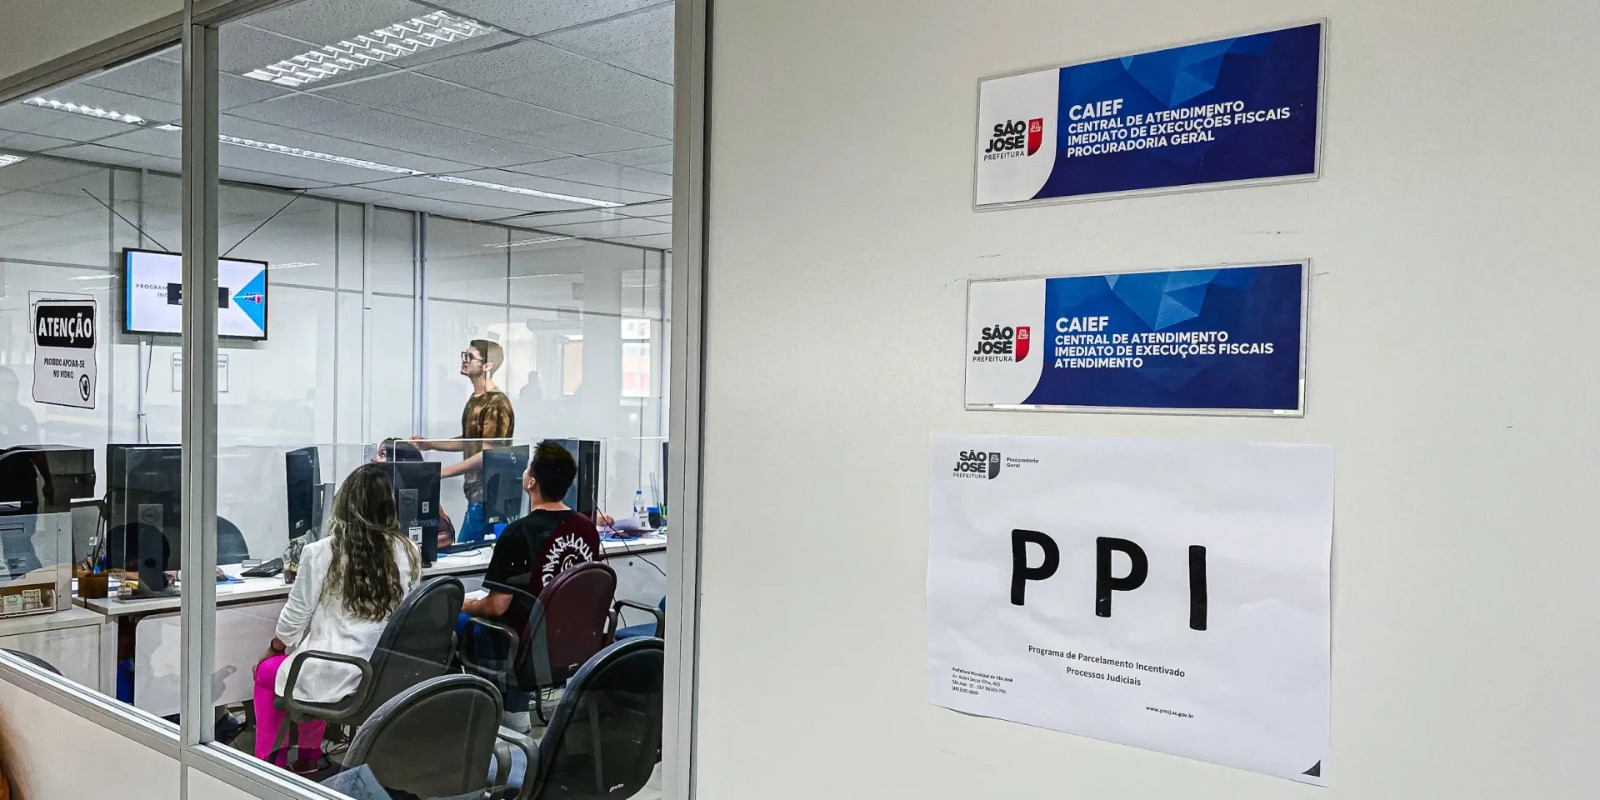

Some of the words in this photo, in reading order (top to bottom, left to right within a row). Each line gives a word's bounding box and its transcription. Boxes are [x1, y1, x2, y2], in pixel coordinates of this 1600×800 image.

[1068, 118, 1123, 134] CENTRAL
[1126, 114, 1143, 127] DE
[1145, 101, 1244, 124] ATENDIMENTO
[1069, 99, 1123, 120] CAIEF
[993, 119, 1026, 137] SÃO
[1068, 129, 1127, 145] IMEDIATO
[1130, 126, 1147, 138] DE
[1150, 113, 1231, 135] EXECUÇÕES
[1234, 107, 1290, 125] FISCAIS
[985, 134, 1025, 153] JOSÉ
[1067, 136, 1167, 157] PROCURADORIA
[1171, 130, 1215, 145] GERAL
[984, 150, 1024, 161] PREFEITURA
[38, 312, 92, 343] ATENÇÃO
[982, 324, 1014, 340] SÃO
[1055, 316, 1109, 332] CAIEF
[974, 339, 1012, 354] JOSÉ
[1055, 334, 1109, 345] CENTRAL
[1112, 333, 1128, 344] DE
[1131, 331, 1228, 344] ATENDIMENTO
[1055, 346, 1114, 356] IMEDIATO
[1116, 345, 1133, 356] DE
[1135, 340, 1216, 358] EXECUÇÕES
[1218, 343, 1273, 354] FISCAIS
[43, 357, 62, 366] PROIBIDO
[62, 359, 85, 368] APOIAR-SE
[1054, 357, 1143, 368] ATENDIMENTO
[60, 371, 74, 379] VIDRO
[959, 449, 987, 462] SÃO
[953, 461, 986, 473] JOSÉ
[1028, 644, 1064, 658] Programa
[1066, 651, 1076, 660] de
[1078, 653, 1134, 669] Parcelamento
[1136, 662, 1185, 678] Incentivado
[1066, 666, 1105, 680] Processos
[1106, 673, 1141, 686] Judiciais
